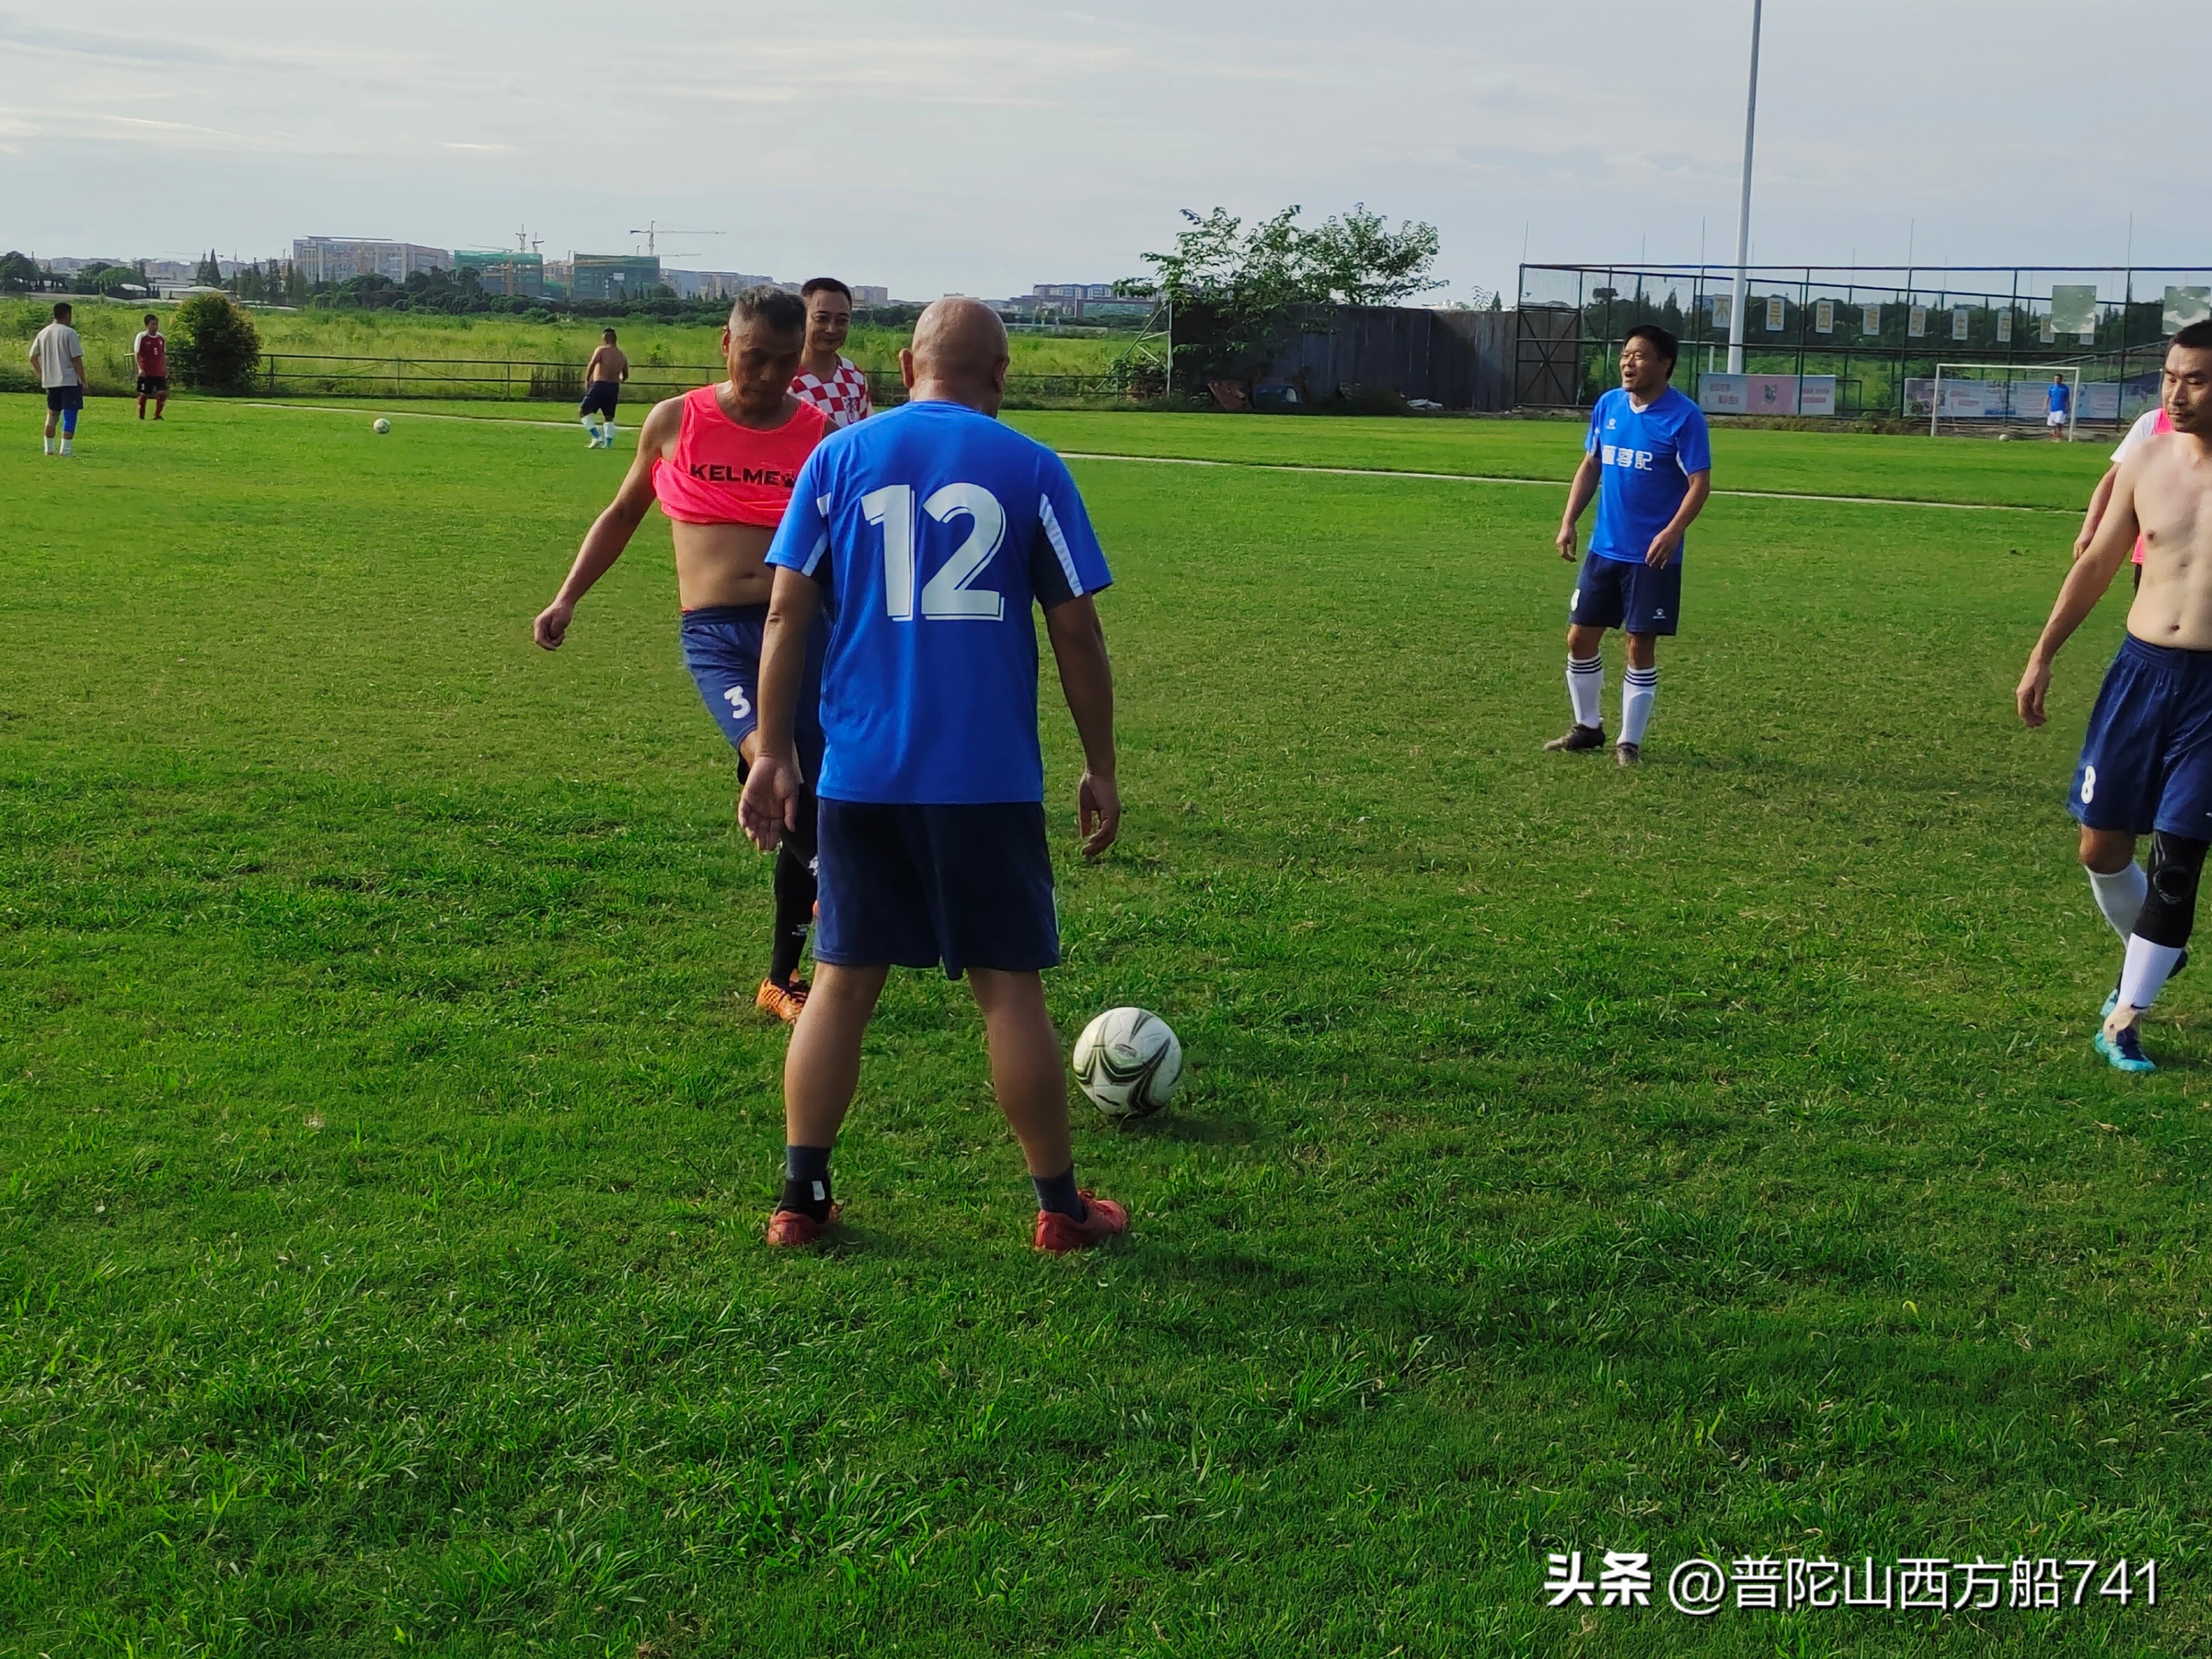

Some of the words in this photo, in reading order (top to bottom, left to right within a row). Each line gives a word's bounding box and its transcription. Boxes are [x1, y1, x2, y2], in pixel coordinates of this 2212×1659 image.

[690, 464, 780, 486] KELME
[861, 483, 1007, 622] 12
[724, 685, 751, 719] 3
[2081, 765, 2096, 804] 8
